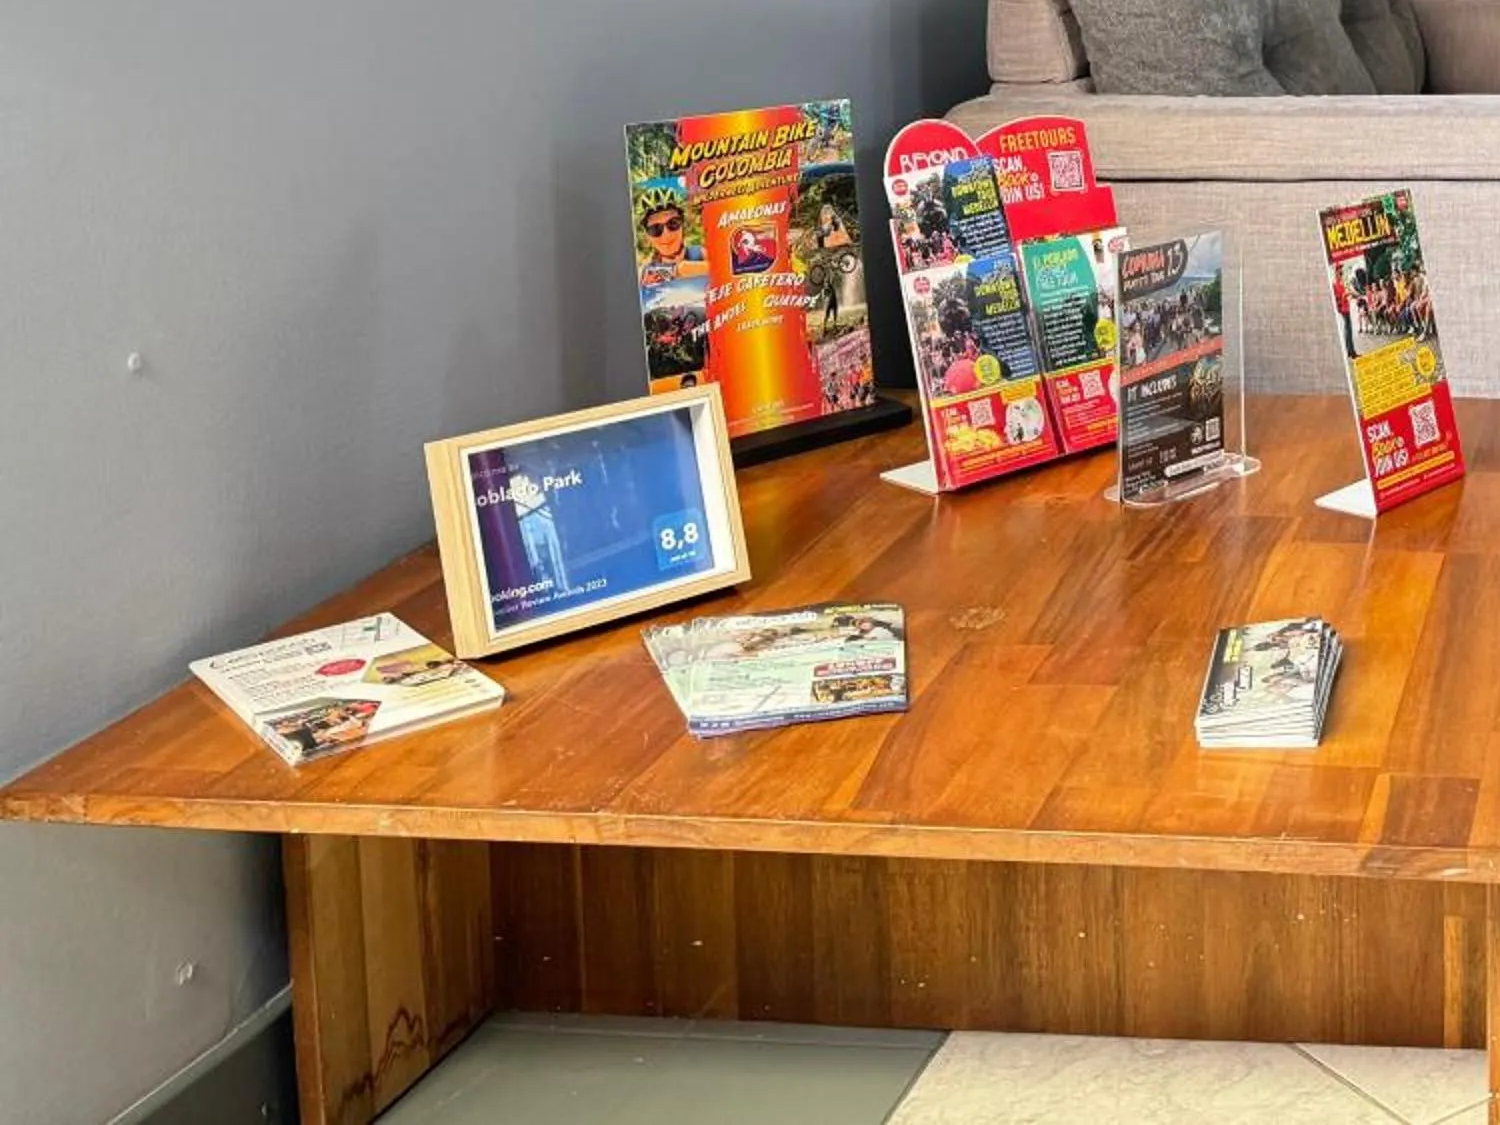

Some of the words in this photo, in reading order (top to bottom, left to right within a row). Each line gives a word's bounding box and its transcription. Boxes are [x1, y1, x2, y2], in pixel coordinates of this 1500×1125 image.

[669, 129, 769, 170] MOUNTAIN
[770, 120, 818, 149] BIKE
[1000, 126, 1077, 154] FREETOURS
[699, 148, 794, 189] COLOMBIA
[475, 475, 540, 508] oblado
[542, 469, 583, 492] Park
[660, 522, 699, 551] 8,8
